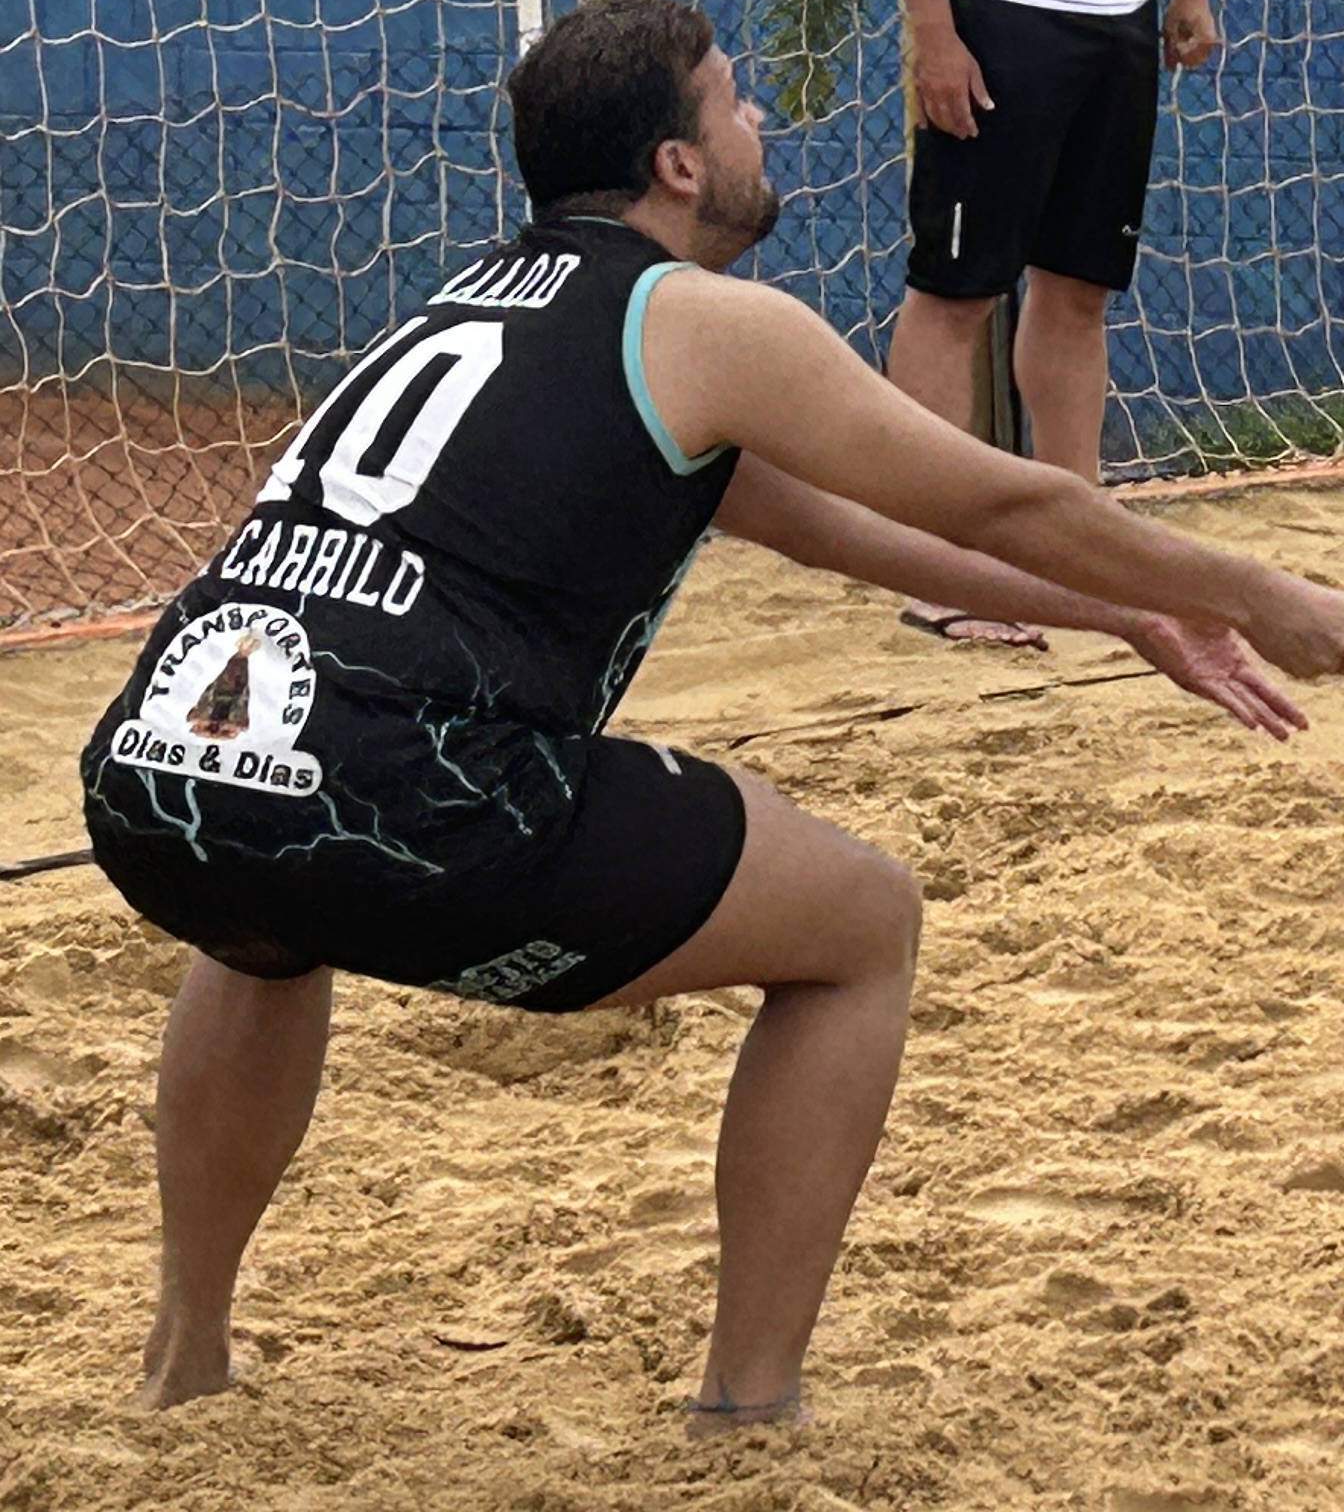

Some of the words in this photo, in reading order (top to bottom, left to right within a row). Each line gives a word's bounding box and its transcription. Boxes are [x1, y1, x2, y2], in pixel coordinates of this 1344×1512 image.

[256, 316, 504, 527] 10
[220, 519, 425, 615] CARRILO
[146, 607, 314, 725] TRANSPORTES
[118, 727, 186, 766] Dias
[199, 744, 220, 773] &
[233, 751, 314, 790] Dias
